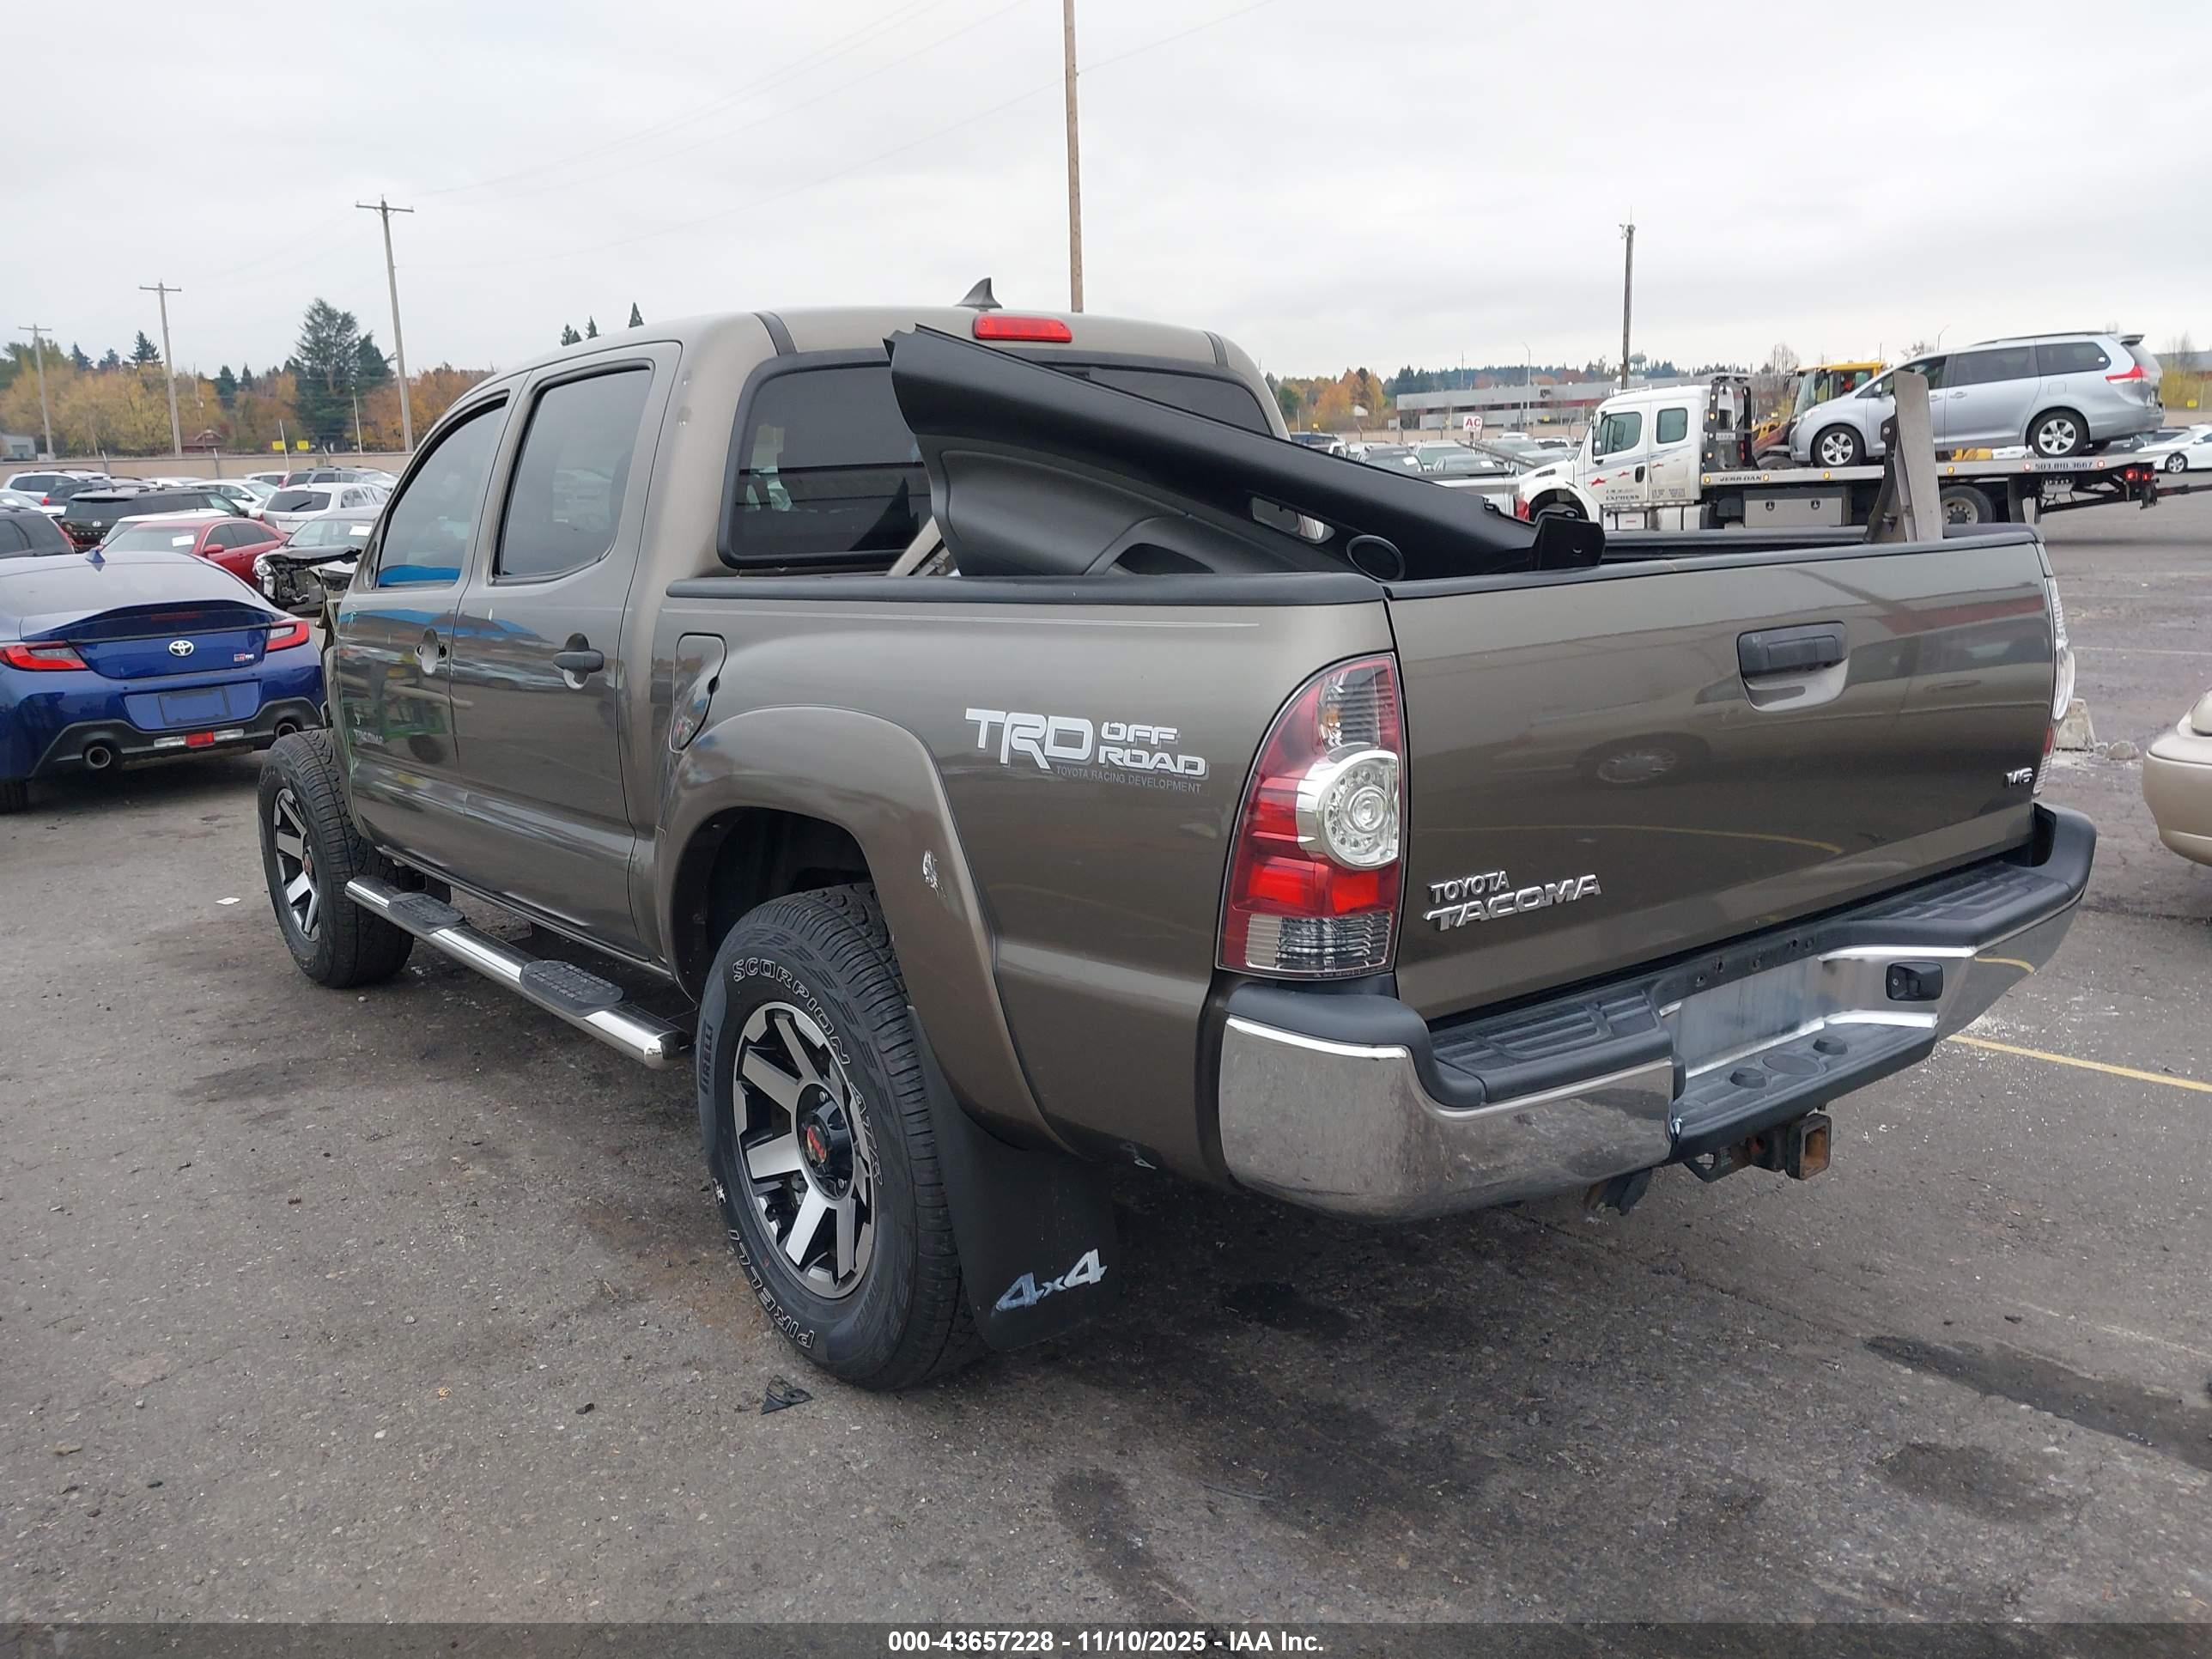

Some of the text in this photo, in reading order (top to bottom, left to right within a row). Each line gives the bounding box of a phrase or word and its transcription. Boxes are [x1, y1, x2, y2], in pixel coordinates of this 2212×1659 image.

[1466, 418, 1480, 427] AC
[965, 708, 1177, 769] TRD OFF
[1097, 744, 1206, 776] ROAD
[1056, 765, 1201, 793] TOYOTA RACING DEVELOPMENT
[1424, 874, 1601, 931] TACOMA
[1428, 871, 1510, 903] TOYOTA
[732, 957, 851, 1065] SCORPION
[728, 1229, 815, 1349] PIRELLI
[994, 1248, 1108, 1312] 4x4
